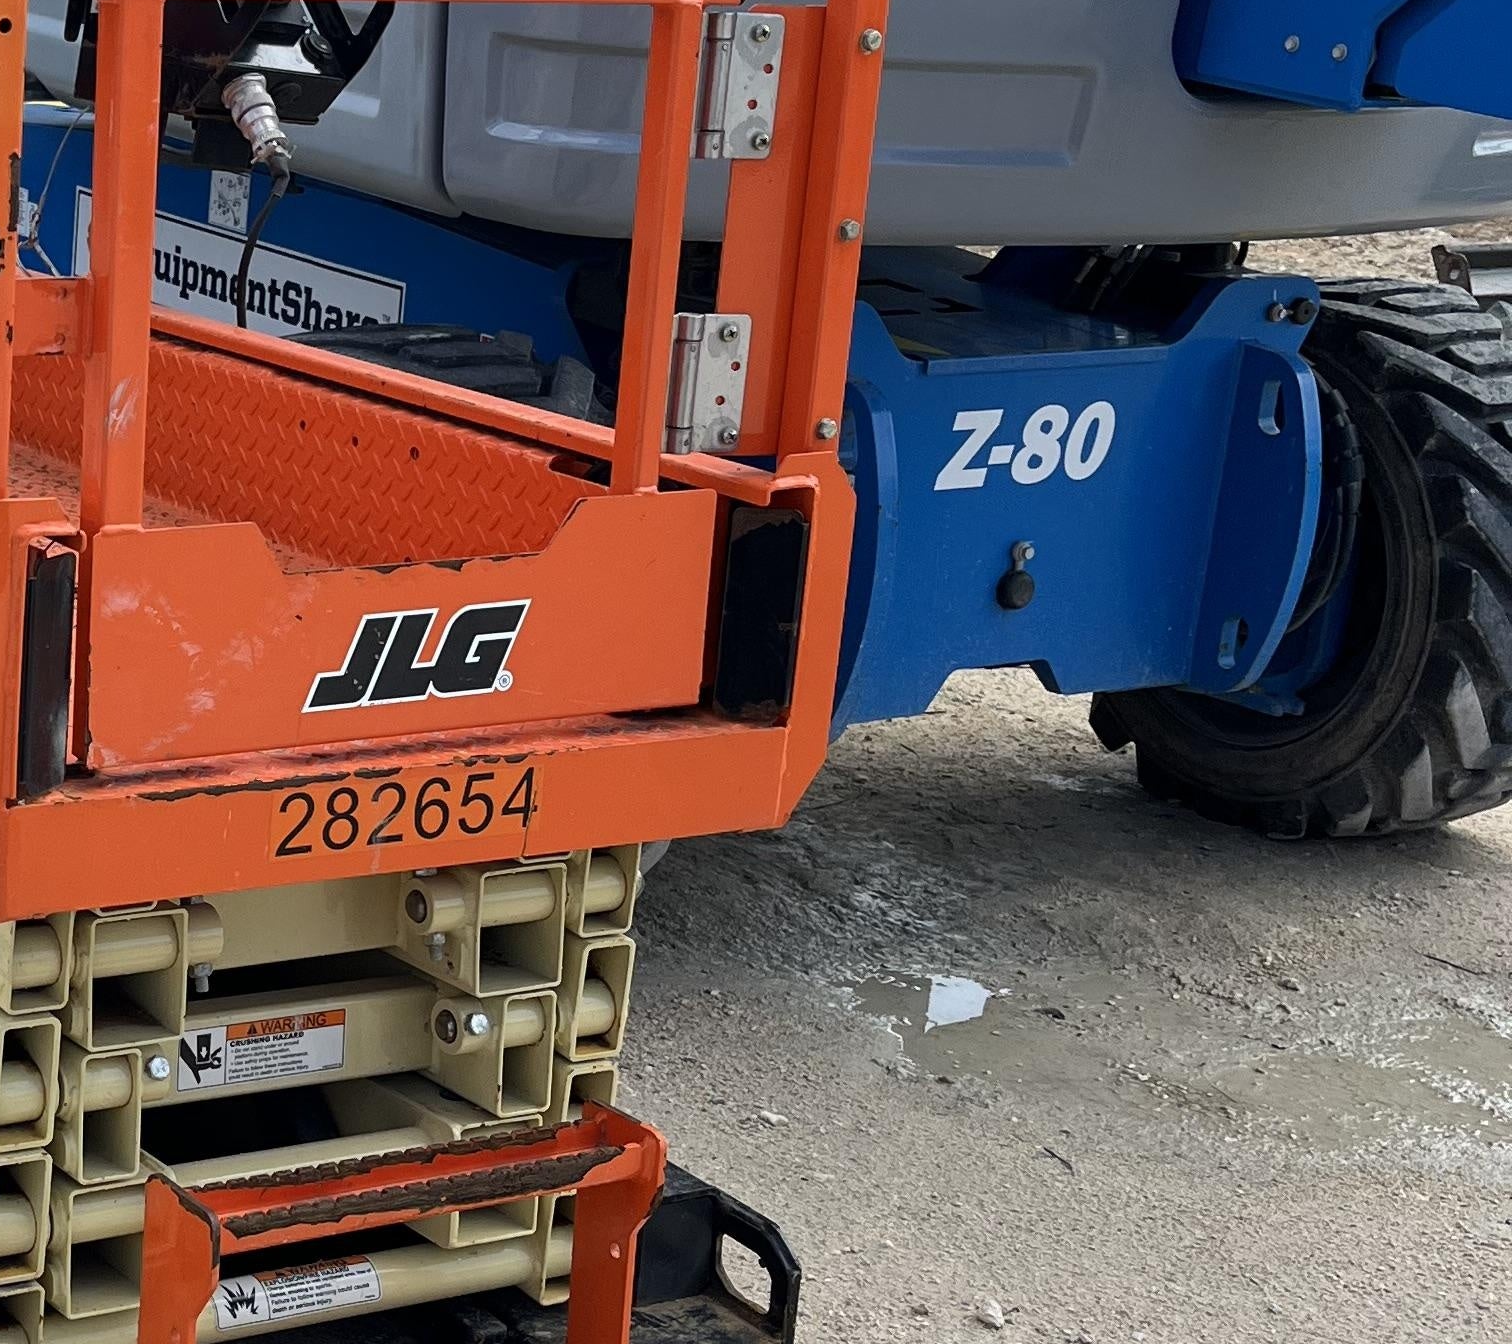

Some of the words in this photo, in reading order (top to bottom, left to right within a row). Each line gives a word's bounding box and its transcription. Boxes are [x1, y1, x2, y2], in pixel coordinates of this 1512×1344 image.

[934, 400, 1116, 491] Z-80
[307, 602, 529, 709] JLG
[274, 767, 538, 858] 282654
[229, 1036, 271, 1048] CRUSHING
[273, 1032, 304, 1042] HAZARD
[262, 1013, 327, 1034] WARING
